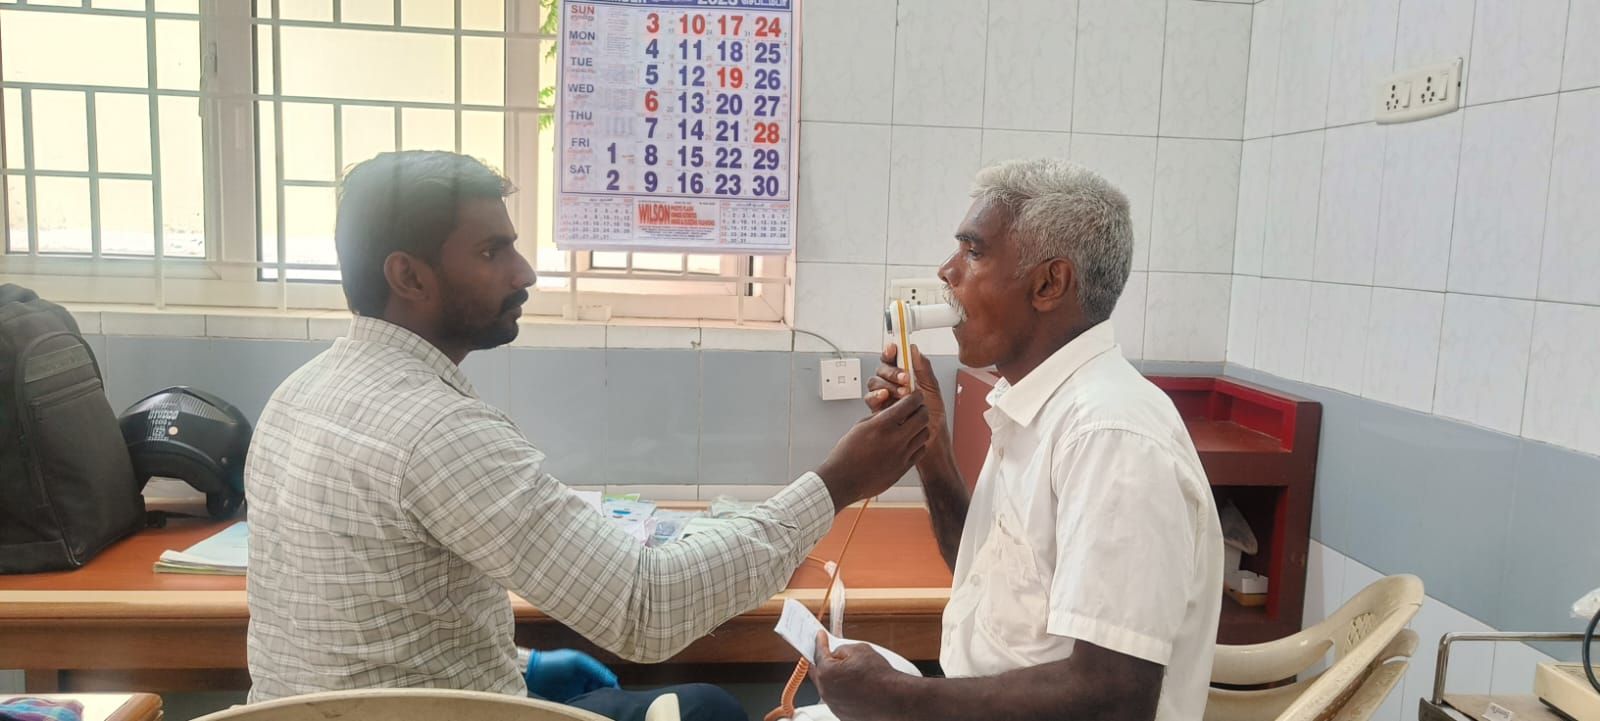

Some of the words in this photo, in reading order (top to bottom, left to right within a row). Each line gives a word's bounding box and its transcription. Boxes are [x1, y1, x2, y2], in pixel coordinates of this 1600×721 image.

[570, 5, 595, 15] SUN
[646, 12, 660, 33] 3
[680, 14, 706, 35] 10
[717, 15, 743, 36] 17
[755, 16, 781, 37] 24
[569, 31, 595, 40] MON
[645, 38, 659, 59] 4
[679, 39, 702, 60] 11
[717, 41, 743, 62] 18
[755, 42, 781, 64] 25
[570, 57, 592, 67] TUE
[645, 64, 659, 85] 5
[678, 65, 705, 86] 12
[717, 67, 743, 88] 19
[754, 68, 781, 90] 26
[568, 83, 594, 93] WED
[645, 90, 659, 112] 6
[678, 92, 704, 114] 13
[716, 93, 743, 115] 20
[754, 95, 780, 116] 27
[569, 111, 592, 120] THU
[645, 117, 658, 138] 7
[678, 118, 704, 140] 14
[716, 120, 739, 142] 21
[754, 122, 780, 144] 28
[571, 138, 590, 147] FRI
[607, 142, 616, 163] 1
[644, 144, 658, 166] 8
[678, 145, 704, 167] 15
[715, 147, 742, 168] 22
[753, 149, 780, 170] 29
[569, 165, 592, 174] SAT
[606, 169, 620, 190] 2
[644, 171, 658, 192] 9
[678, 172, 704, 194] 16
[715, 173, 741, 195] 23
[752, 175, 779, 197] 30
[638, 203, 671, 225] WILSON
